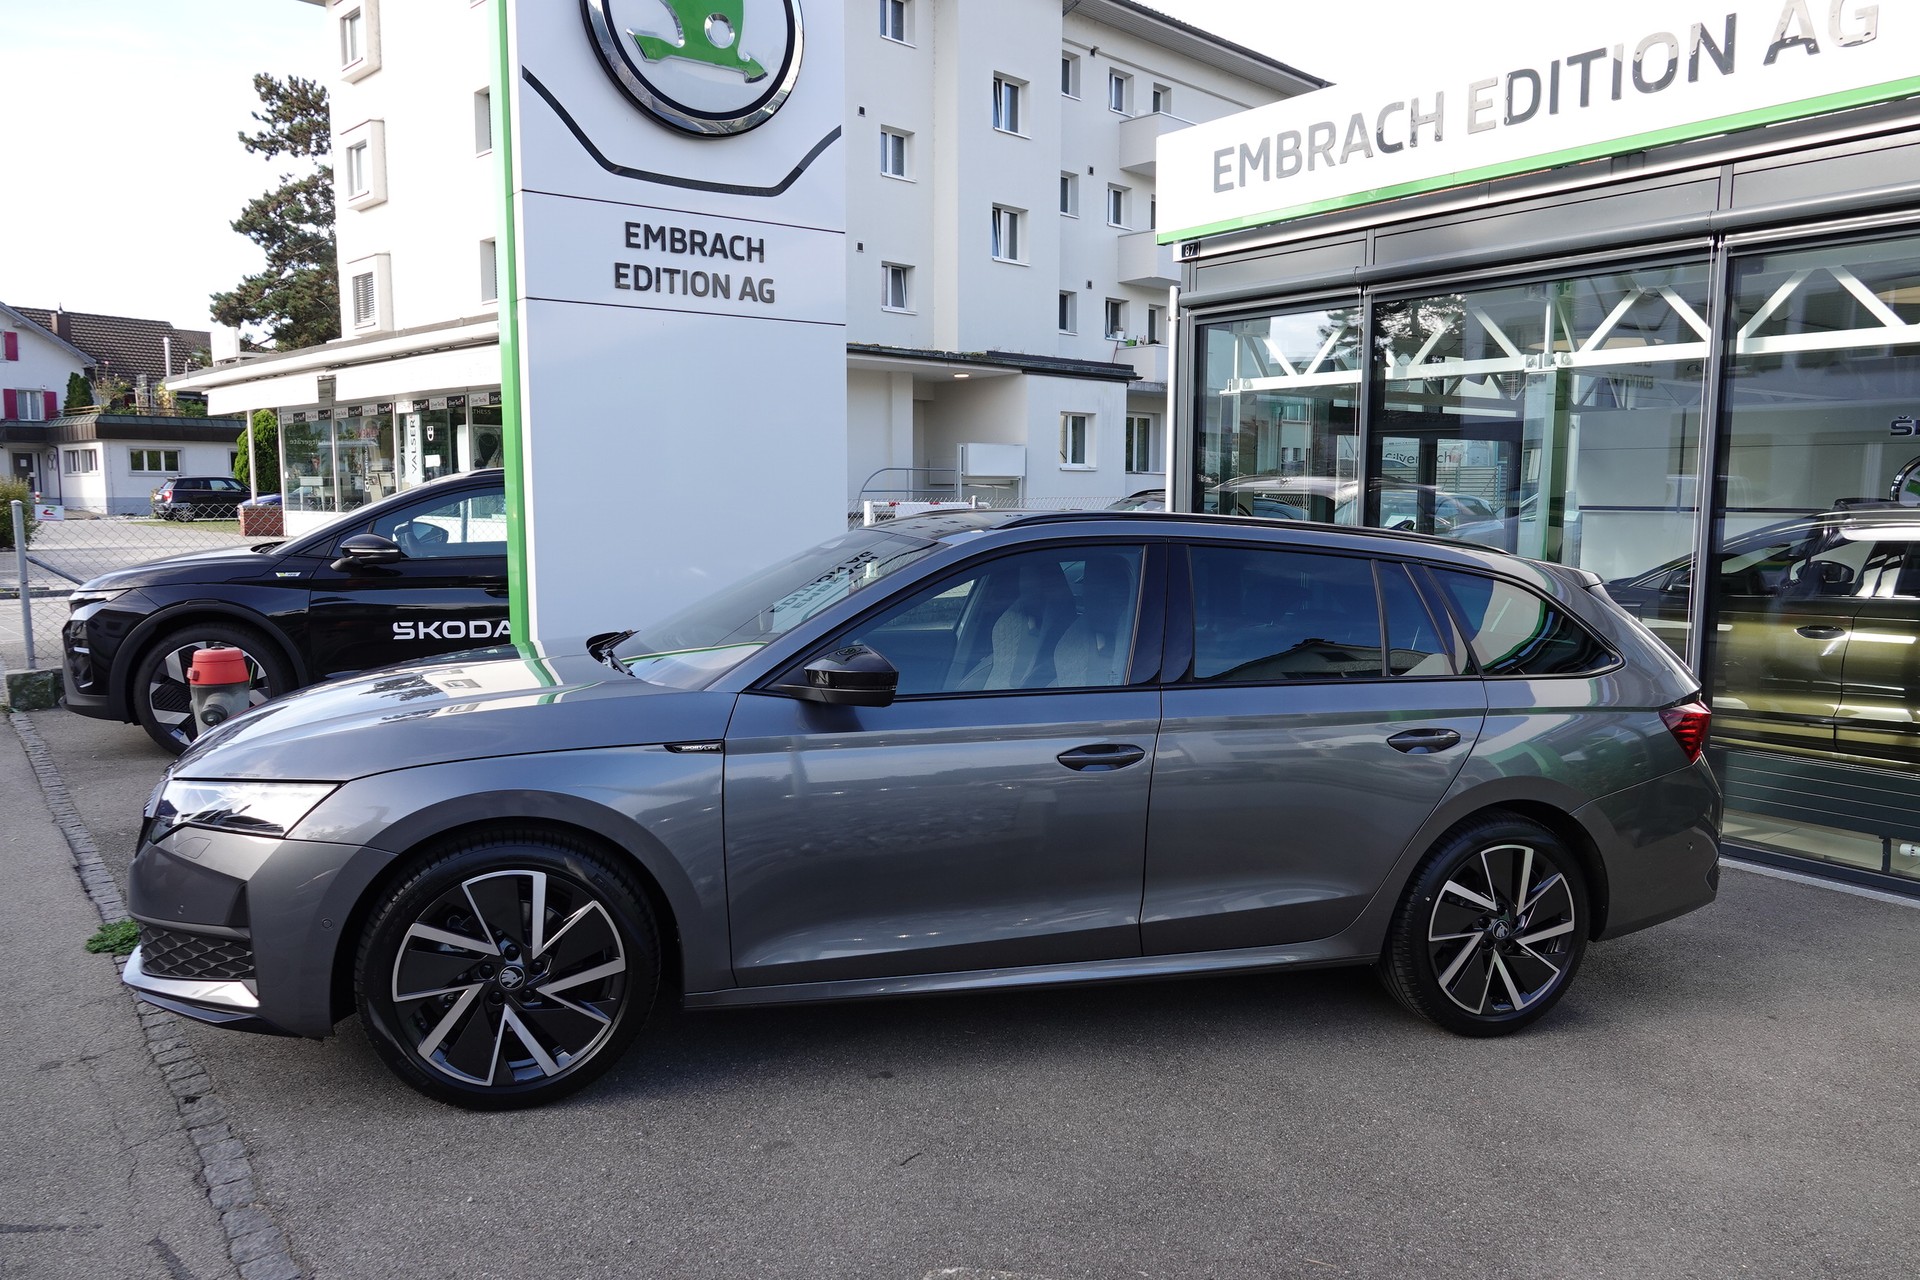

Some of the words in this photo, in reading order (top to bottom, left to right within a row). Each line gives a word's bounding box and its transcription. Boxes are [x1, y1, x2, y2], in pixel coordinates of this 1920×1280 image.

[1213, 90, 1445, 194] EMBRACH
[1467, 12, 1737, 135] EDITION
[1763, 0, 1879, 66] AG
[625, 221, 764, 263] EMBRACH
[1185, 244, 1195, 257] 87
[614, 262, 731, 300] EDITION
[738, 276, 775, 304] AG
[1890, 415, 1920, 436] Š
[409, 419, 418, 475] VALSER
